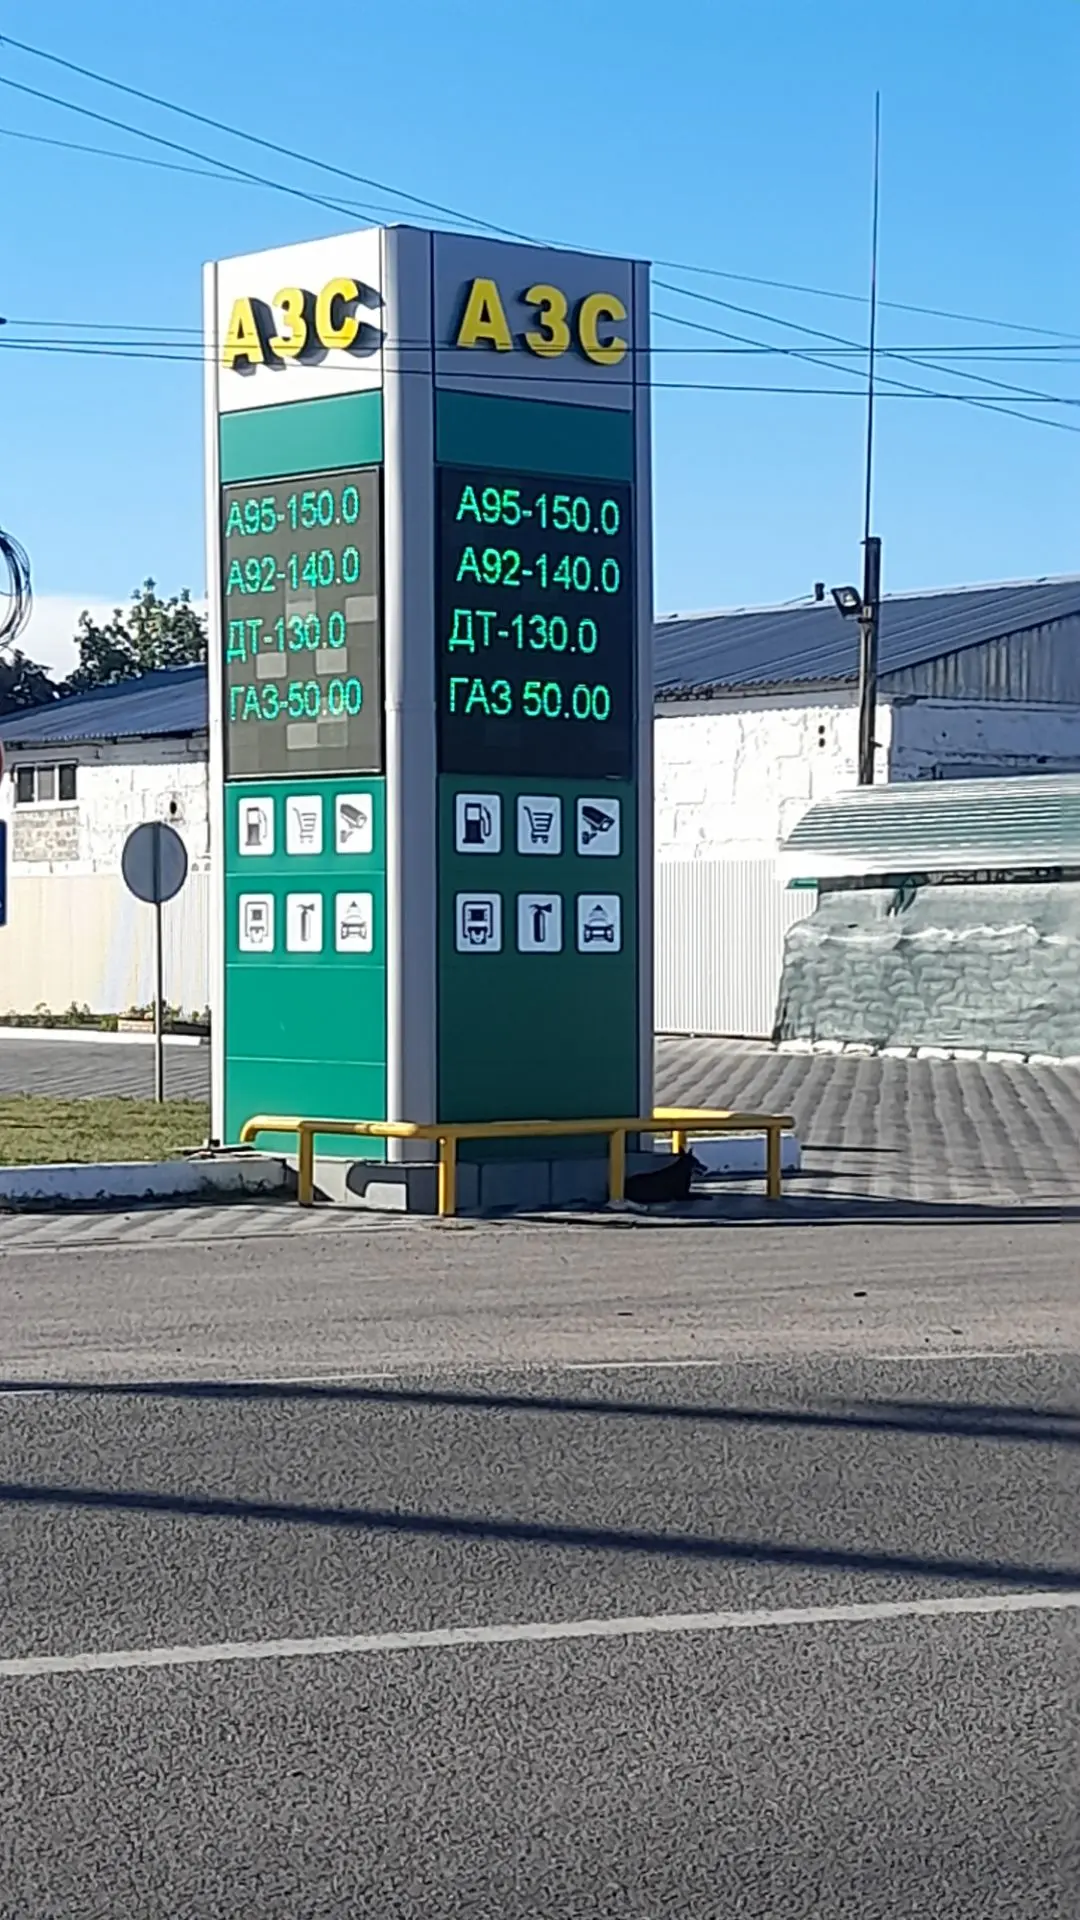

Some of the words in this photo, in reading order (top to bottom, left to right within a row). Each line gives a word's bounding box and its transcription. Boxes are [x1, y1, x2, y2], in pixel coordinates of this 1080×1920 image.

[456, 485, 620, 536] А95-150.0
[456, 546, 620, 593] А92-140.0
[226, 611, 346, 664] ДТ-130.0
[448, 608, 598, 653] ДТ-130.0
[229, 678, 363, 721] ГАЗ-50.00
[449, 677, 513, 716] ГАЗ
[523, 681, 611, 720] 50.00
